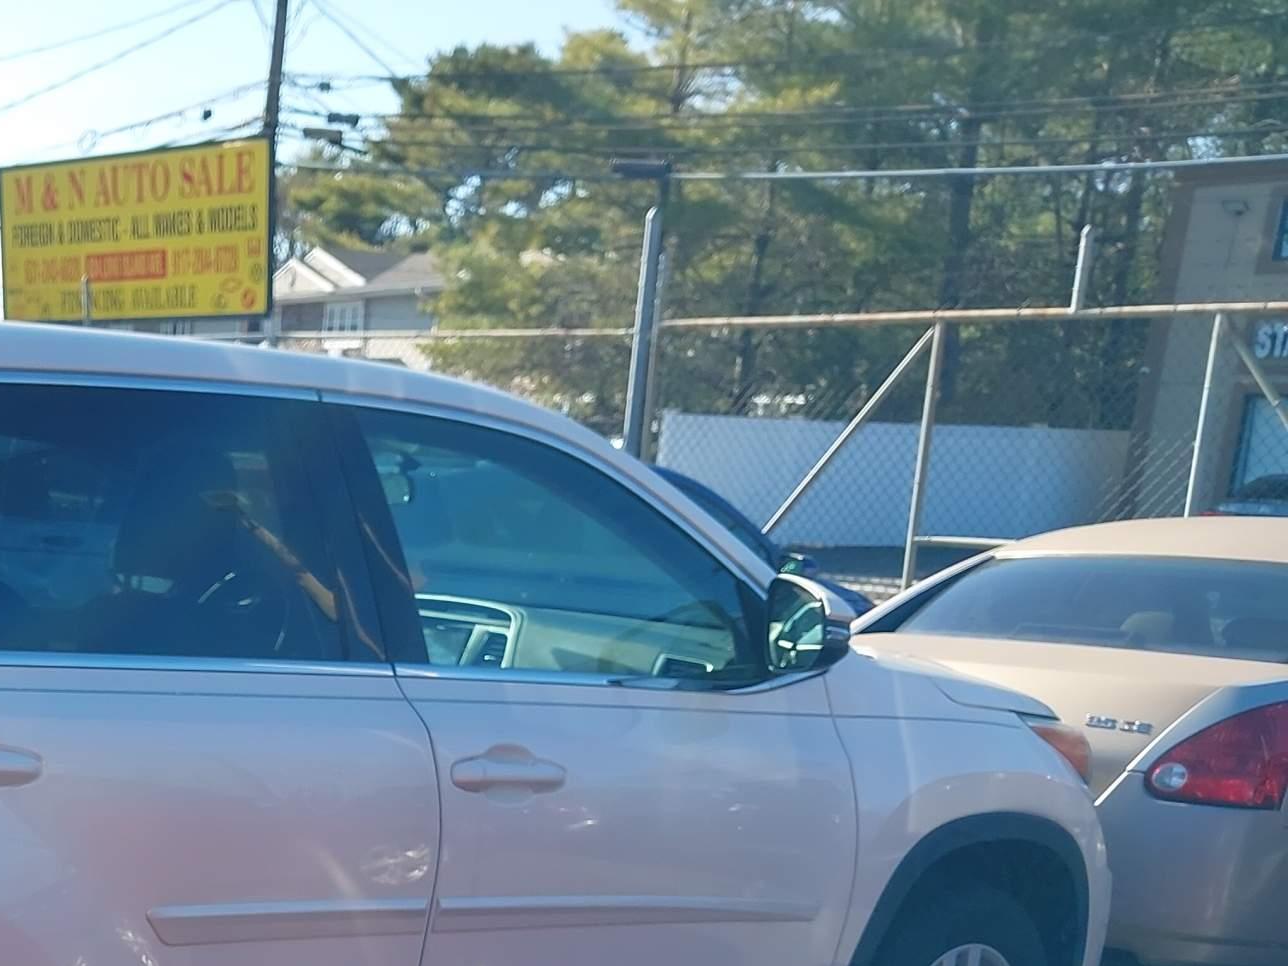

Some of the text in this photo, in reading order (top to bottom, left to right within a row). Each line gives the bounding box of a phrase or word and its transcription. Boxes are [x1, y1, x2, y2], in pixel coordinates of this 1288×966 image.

[15, 151, 257, 214] M & N AUTO SALE
[66, 216, 120, 245] DOMESTIC
[130, 212, 150, 239] ALL
[155, 210, 190, 238] MAKES
[196, 208, 204, 235] &
[209, 205, 258, 235] MODELS
